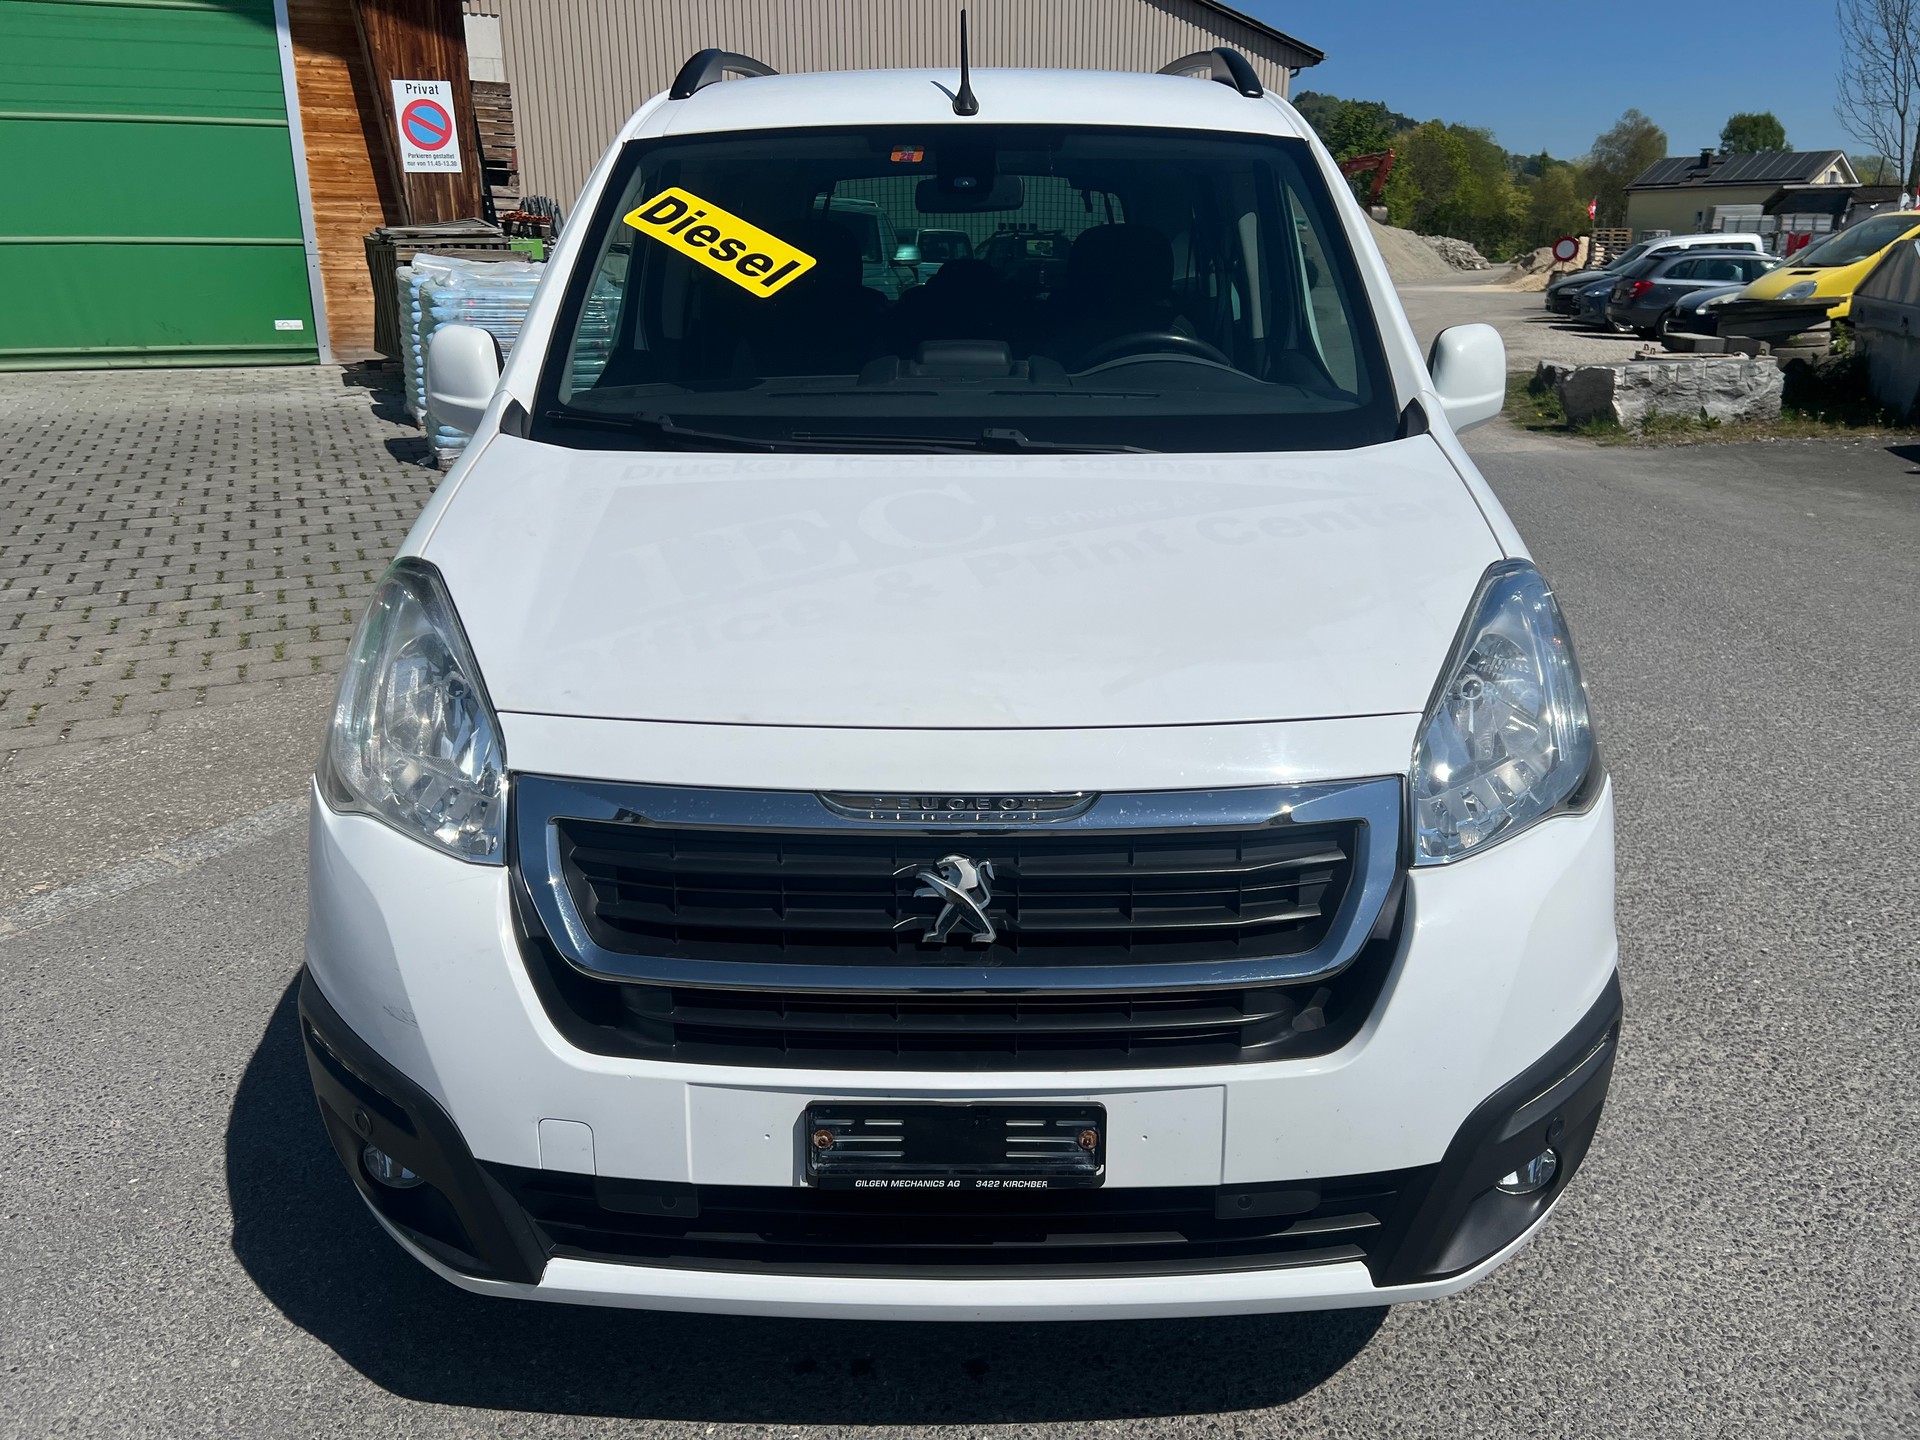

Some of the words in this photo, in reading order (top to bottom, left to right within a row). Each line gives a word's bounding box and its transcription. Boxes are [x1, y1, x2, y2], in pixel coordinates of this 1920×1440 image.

[405, 83, 439, 95] Privat
[637, 195, 802, 288] Diesel
[619, 456, 798, 481] Drucker
[873, 570, 944, 609] &
[962, 526, 1184, 589] Print
[1196, 496, 1462, 546] Center
[871, 798, 1044, 811] PEUGEOT
[855, 1179, 889, 1188] GILGEN
[890, 1179, 946, 1188] MECHANICS
[946, 1179, 961, 1188] AG
[975, 1180, 1001, 1188] 3422
